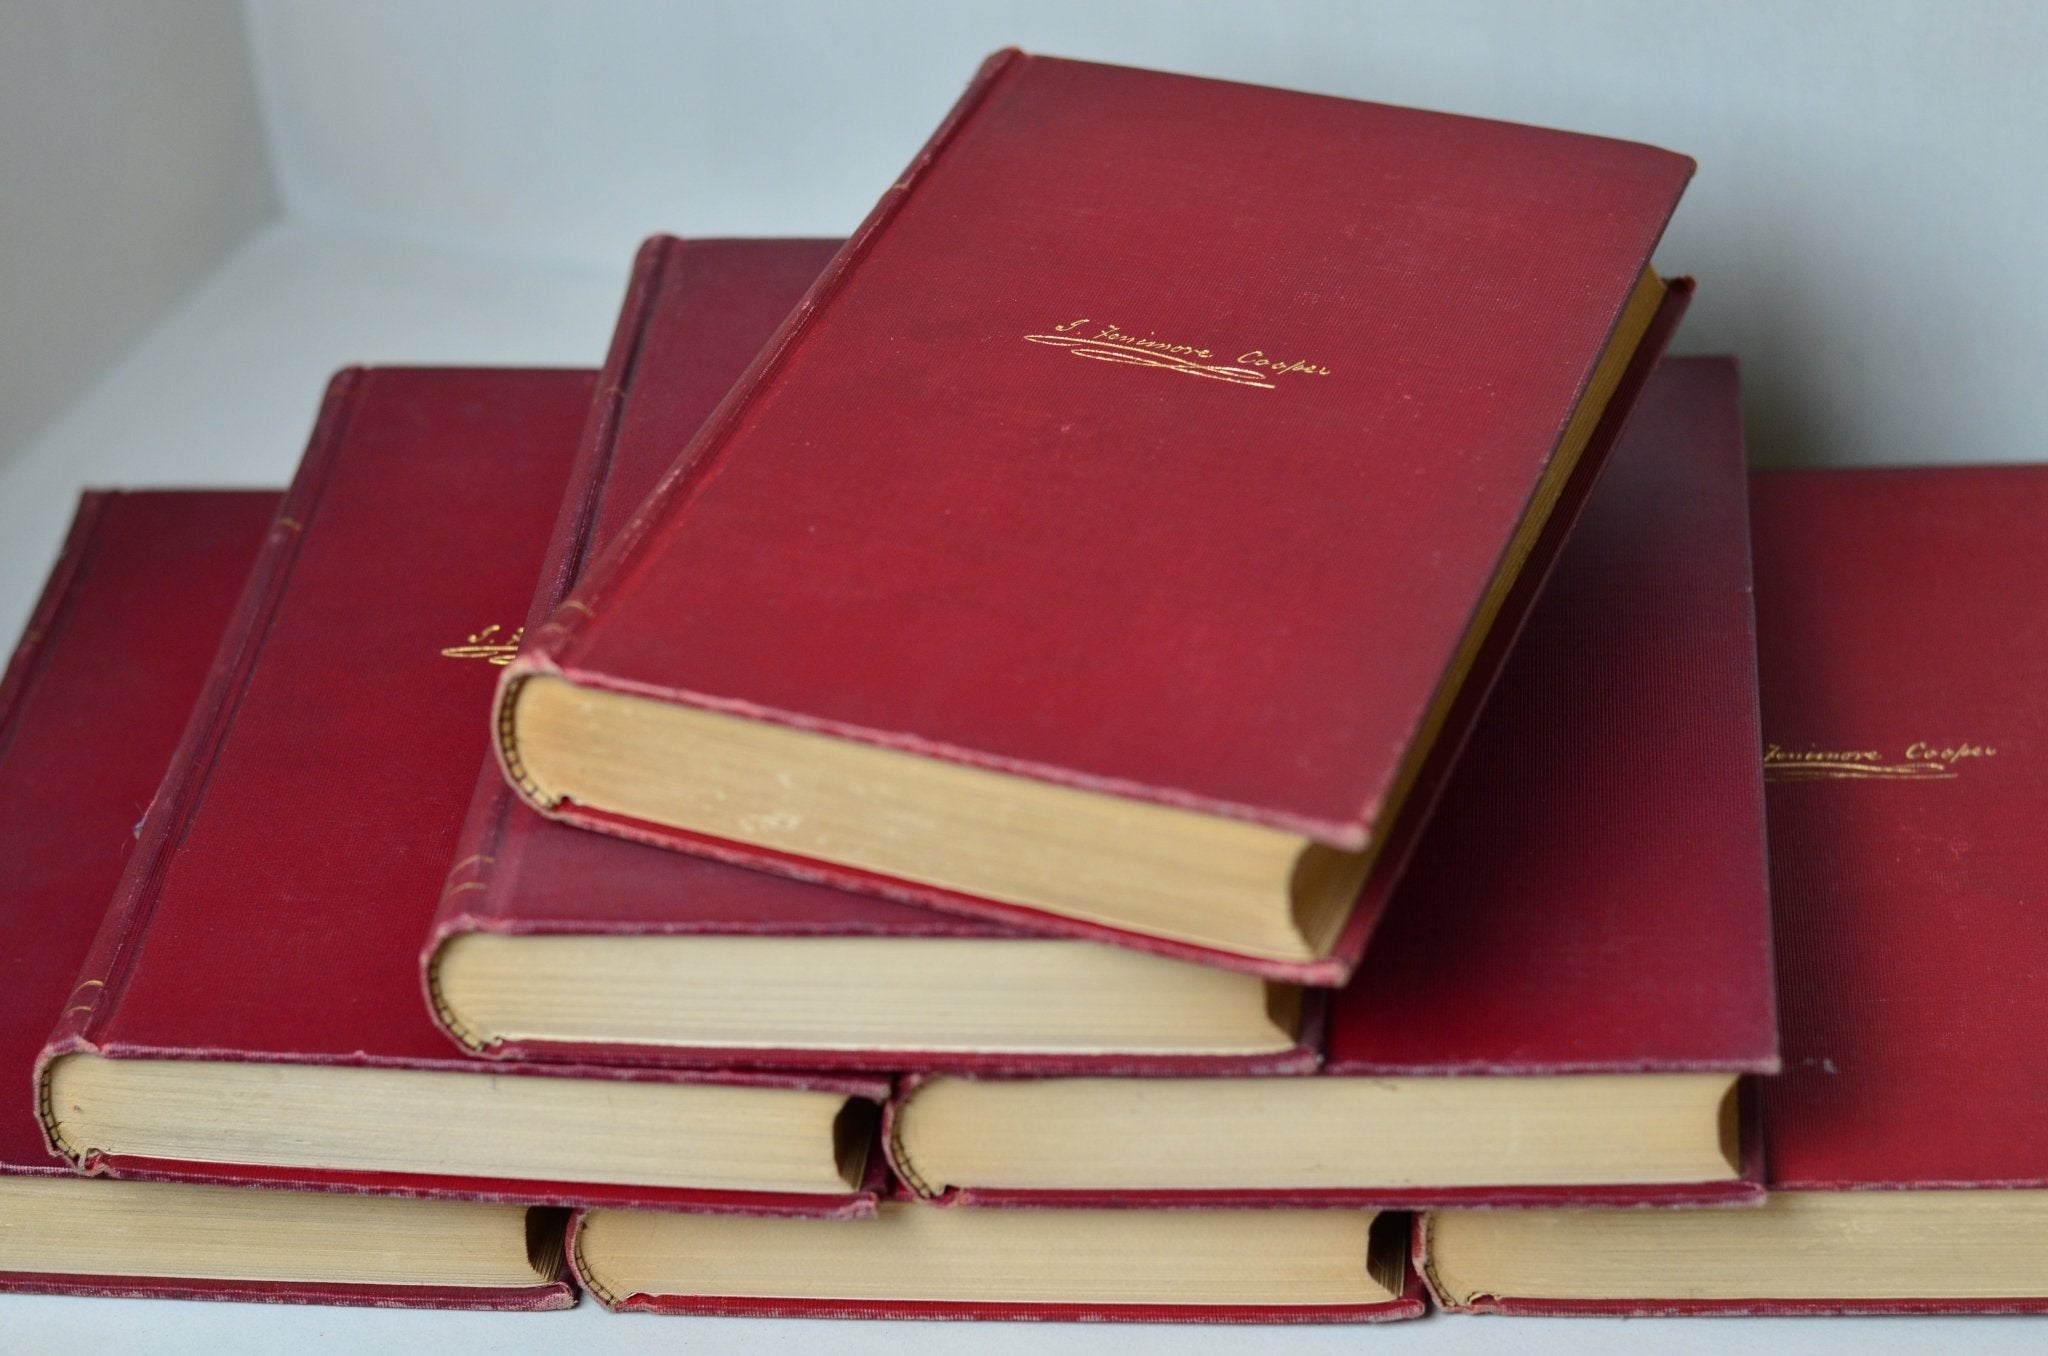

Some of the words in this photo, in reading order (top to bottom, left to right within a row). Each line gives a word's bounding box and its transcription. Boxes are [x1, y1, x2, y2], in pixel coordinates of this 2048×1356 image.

[1093, 324, 1213, 358] Fenimore
[1237, 350, 1331, 375] Cooper
[1905, 741, 1997, 763] Cooper
